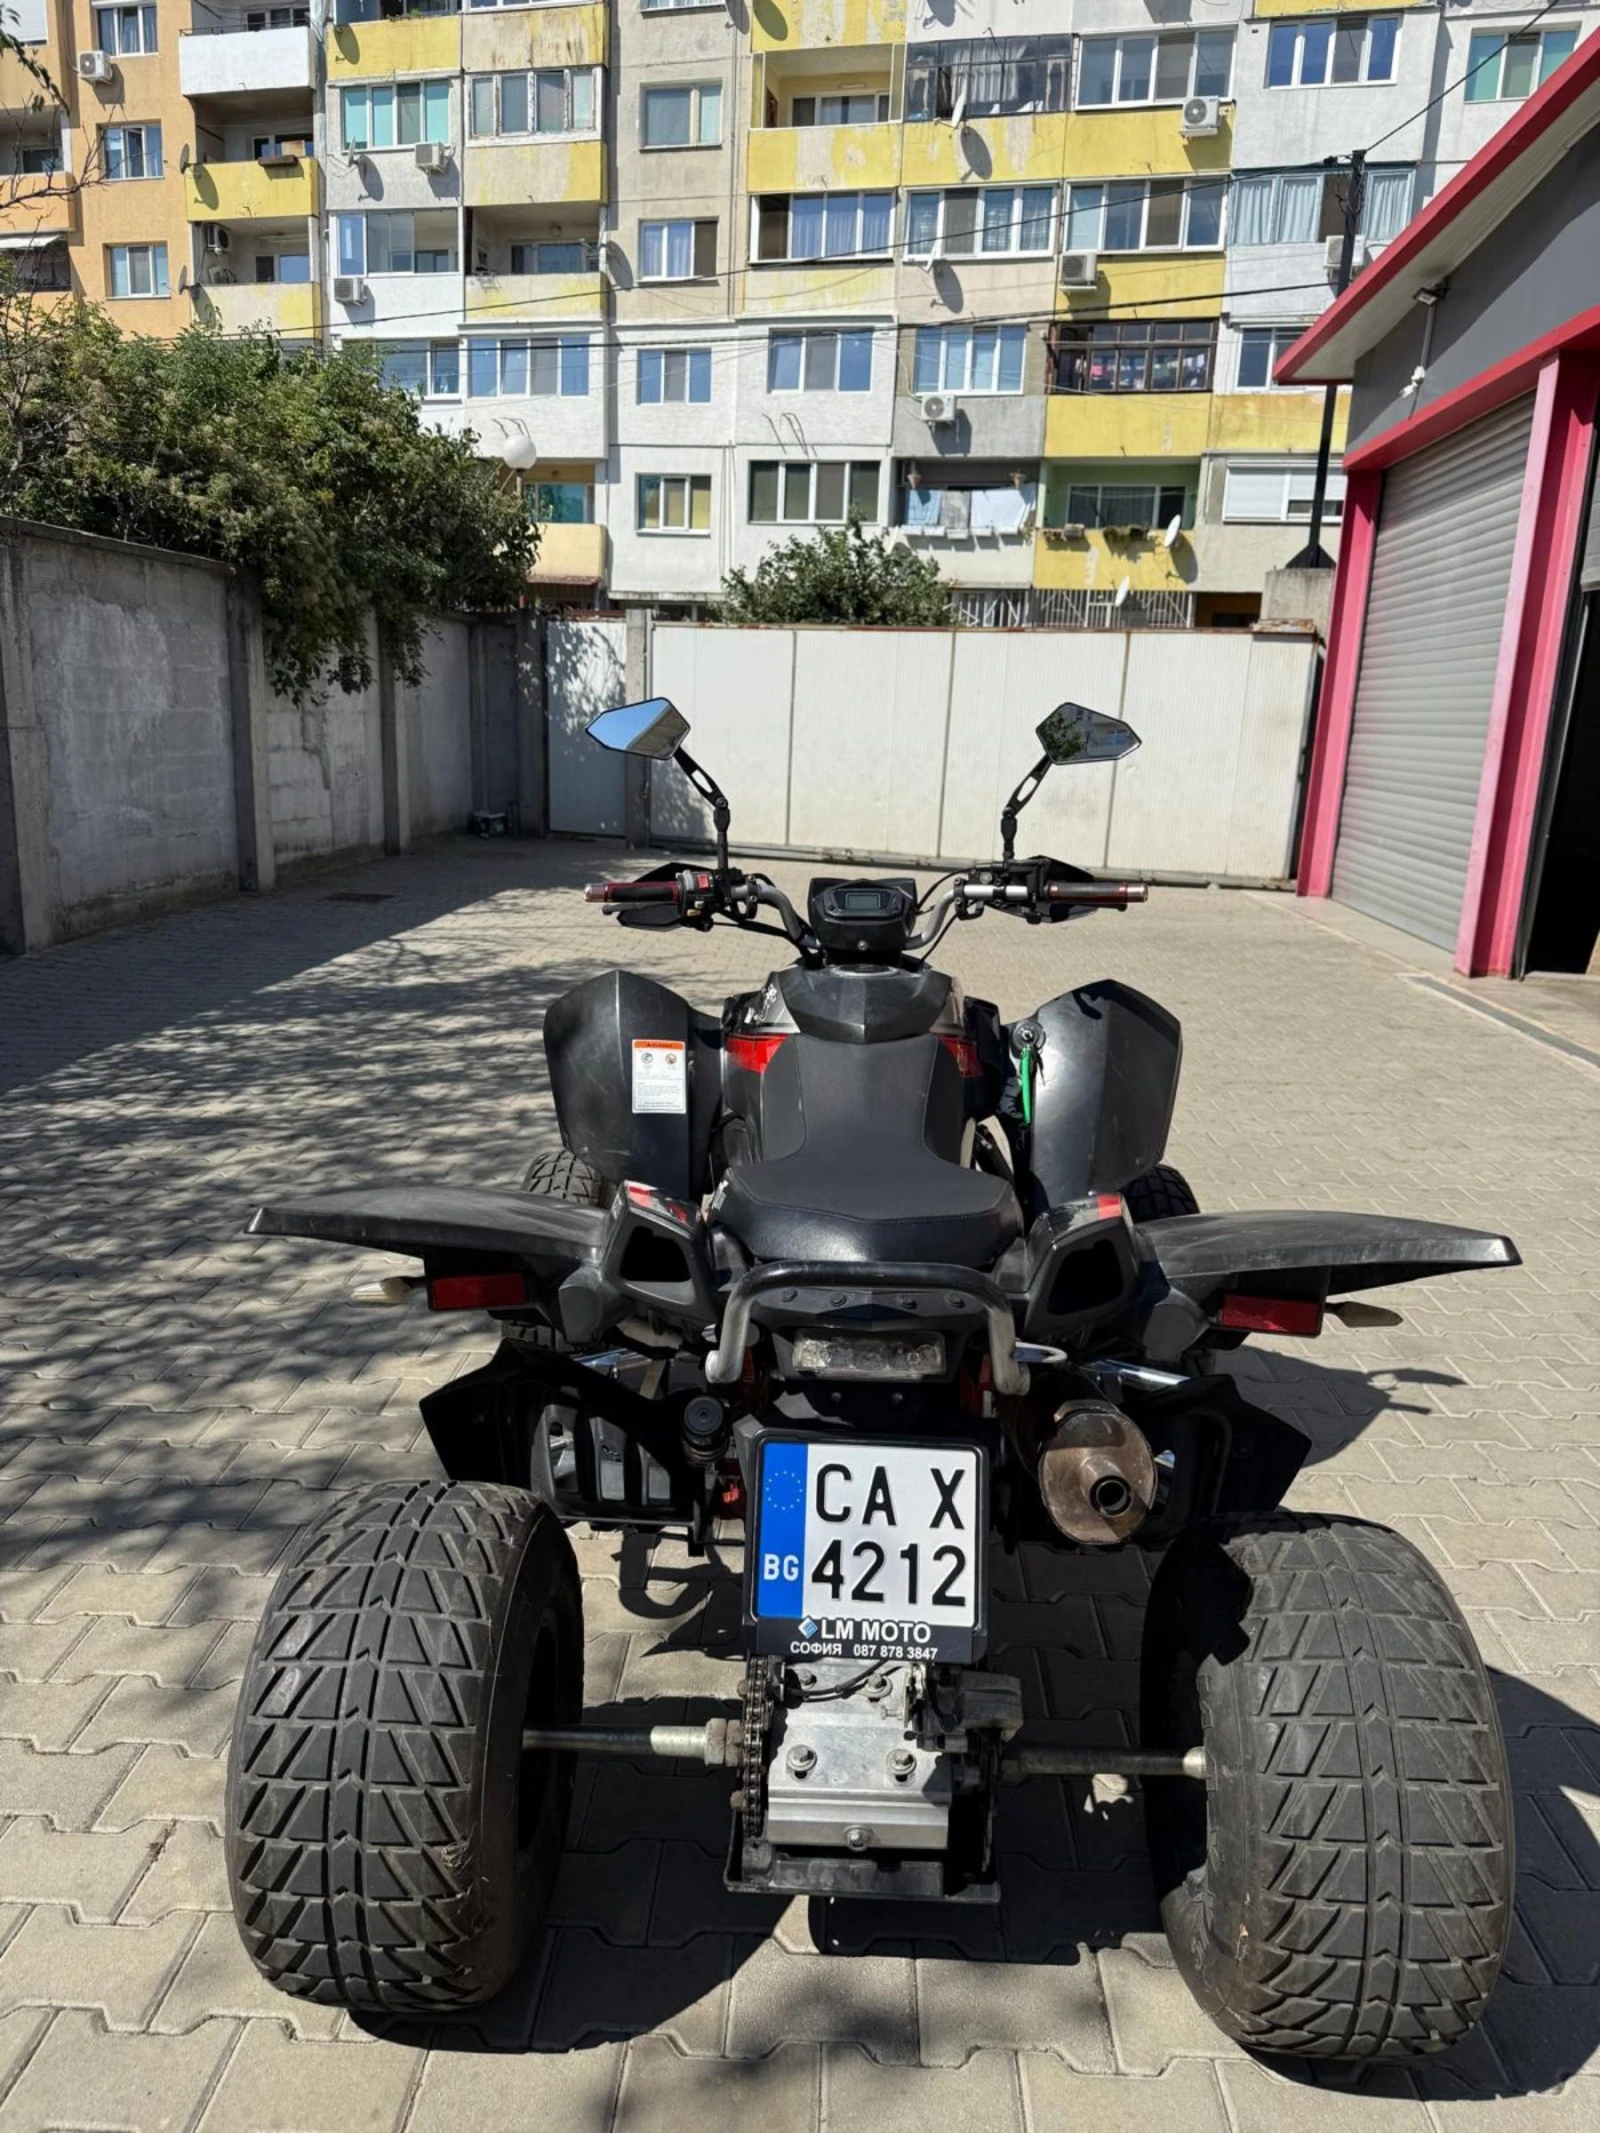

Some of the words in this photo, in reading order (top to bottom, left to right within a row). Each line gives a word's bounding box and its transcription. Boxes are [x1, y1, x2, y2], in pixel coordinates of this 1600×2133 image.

[816, 1463, 897, 1527] CA
[929, 1468, 966, 1530] X
[763, 1554, 800, 1581] BG
[811, 1539, 967, 1607] 4212
[821, 1619, 854, 1641] LM
[861, 1621, 932, 1644] MOTO
[789, 1641, 842, 1656] СОФИЯ
[853, 1644, 876, 1657] 087
[880, 1645, 904, 1658] 878
[907, 1647, 938, 1660] 3847
